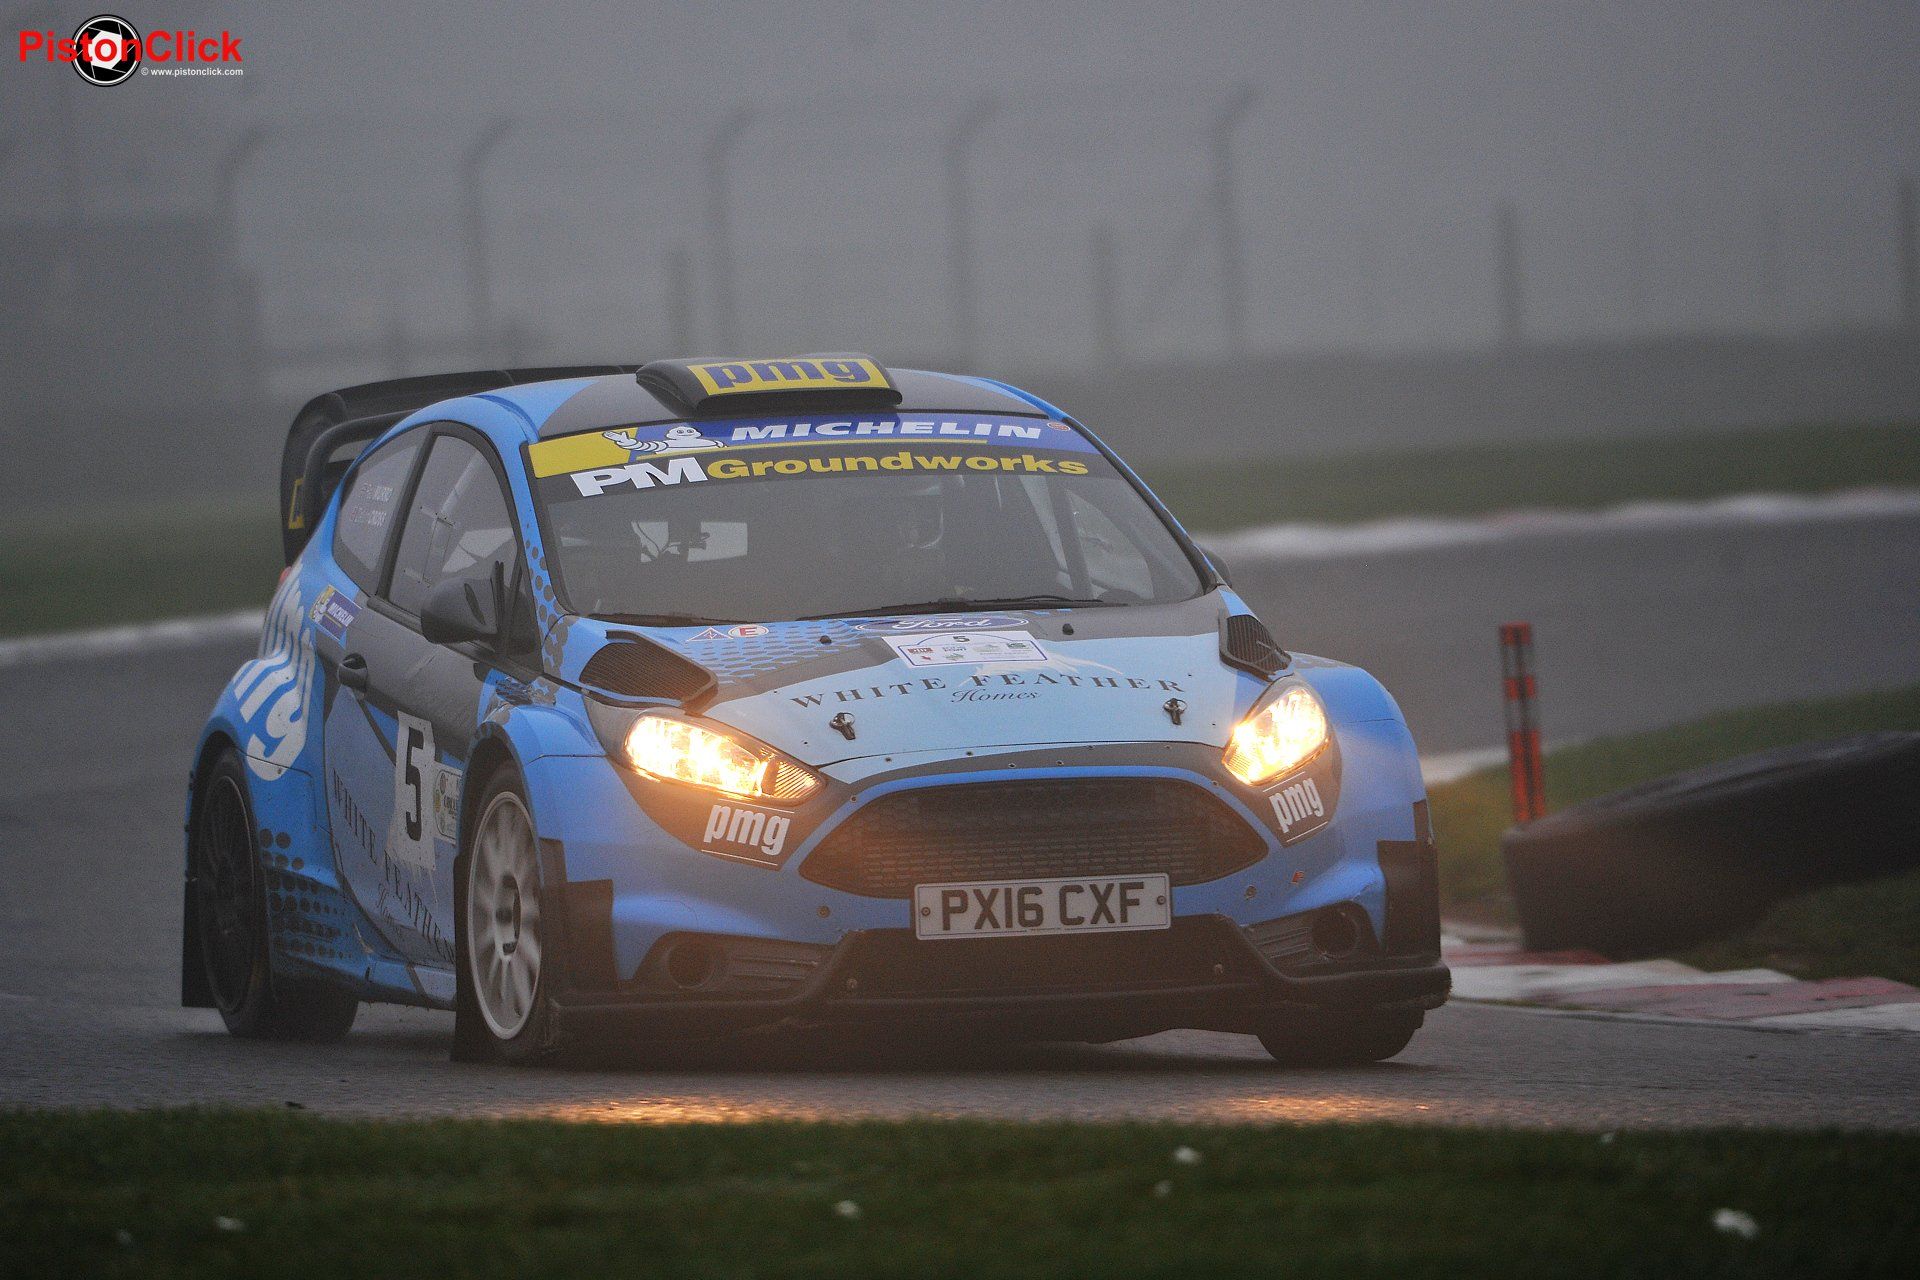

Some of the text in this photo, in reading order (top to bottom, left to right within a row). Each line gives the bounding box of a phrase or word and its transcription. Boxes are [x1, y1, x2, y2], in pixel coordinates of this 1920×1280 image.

[704, 361, 870, 389] pmg
[731, 421, 1041, 441] MICHELIN
[892, 618, 991, 630] Ford
[790, 672, 1186, 709] WHITE FEATHER
[950, 688, 1042, 703] Homes
[405, 727, 424, 842] 5
[1268, 777, 1324, 834] pmg
[333, 768, 377, 865] WHITE
[703, 804, 790, 856] pmg
[941, 881, 1144, 931] PX16 CXF
